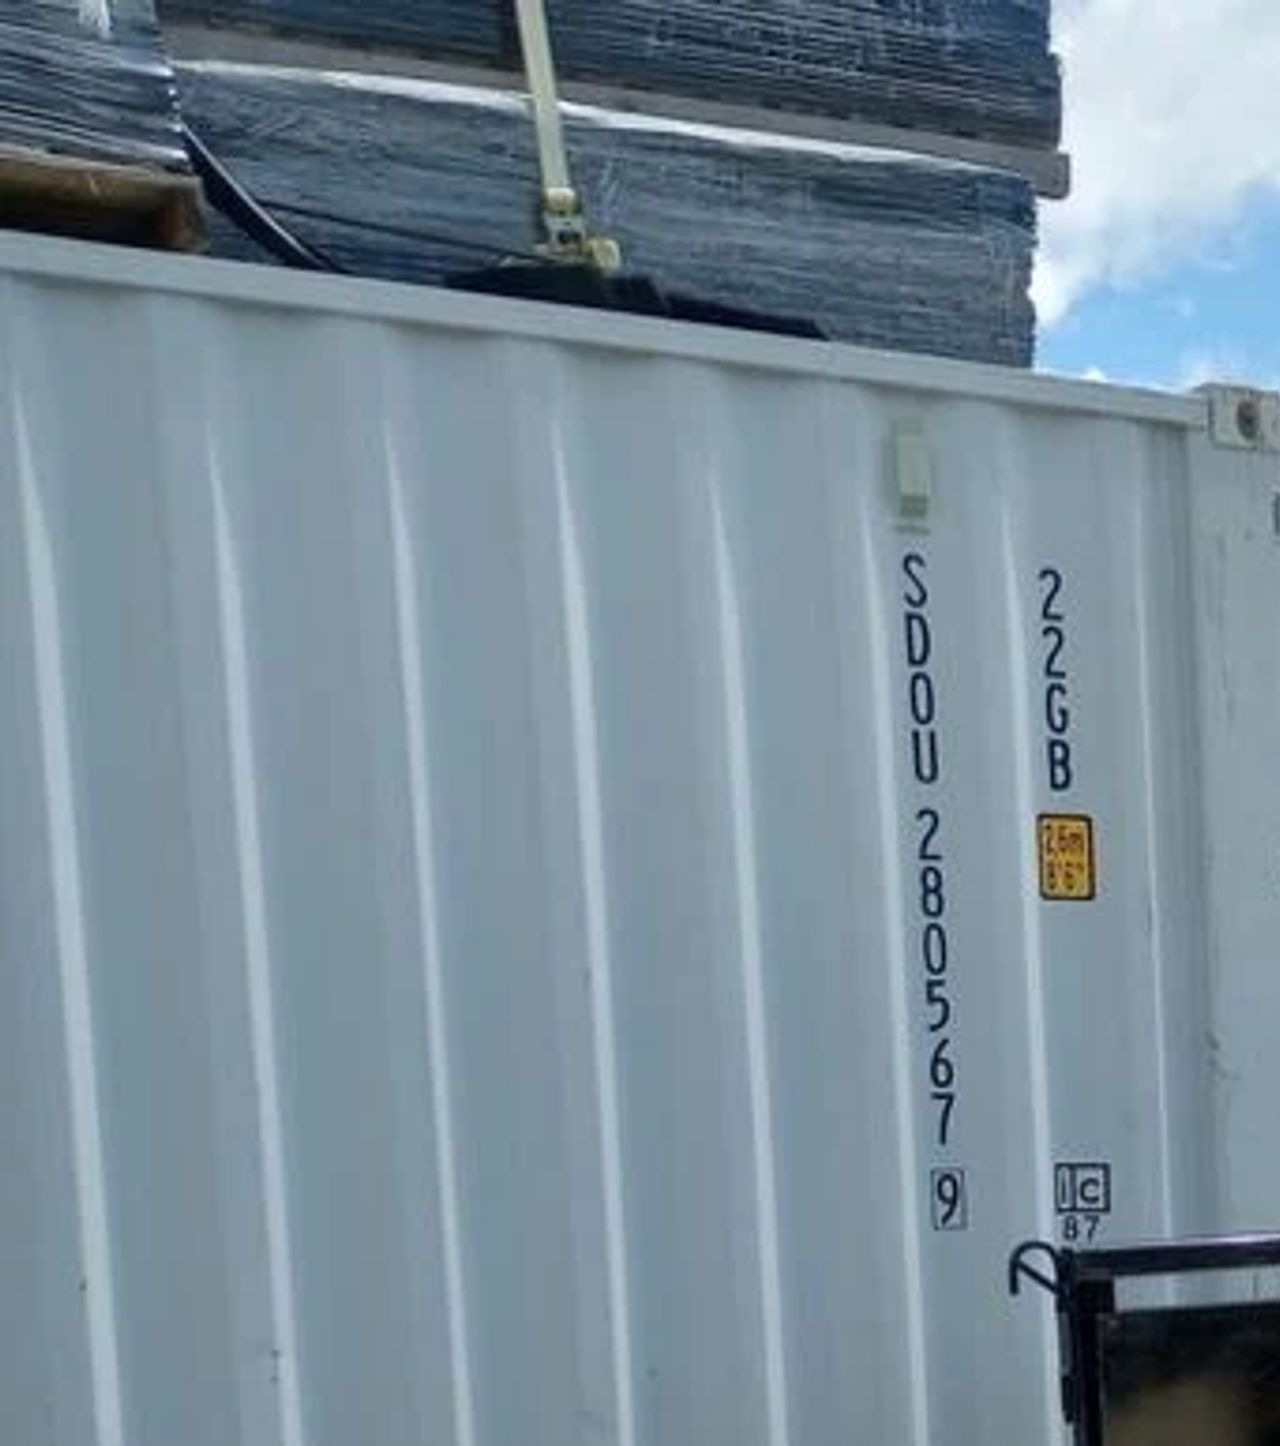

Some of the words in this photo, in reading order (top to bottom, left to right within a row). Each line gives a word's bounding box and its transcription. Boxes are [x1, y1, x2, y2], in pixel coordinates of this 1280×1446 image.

[903, 553, 939, 784] SDOU
[1039, 568, 1072, 790] 22GB
[915, 807, 955, 1146] 280567
[937, 1172, 959, 1226] 9
[1063, 1213, 1100, 1242] 87
